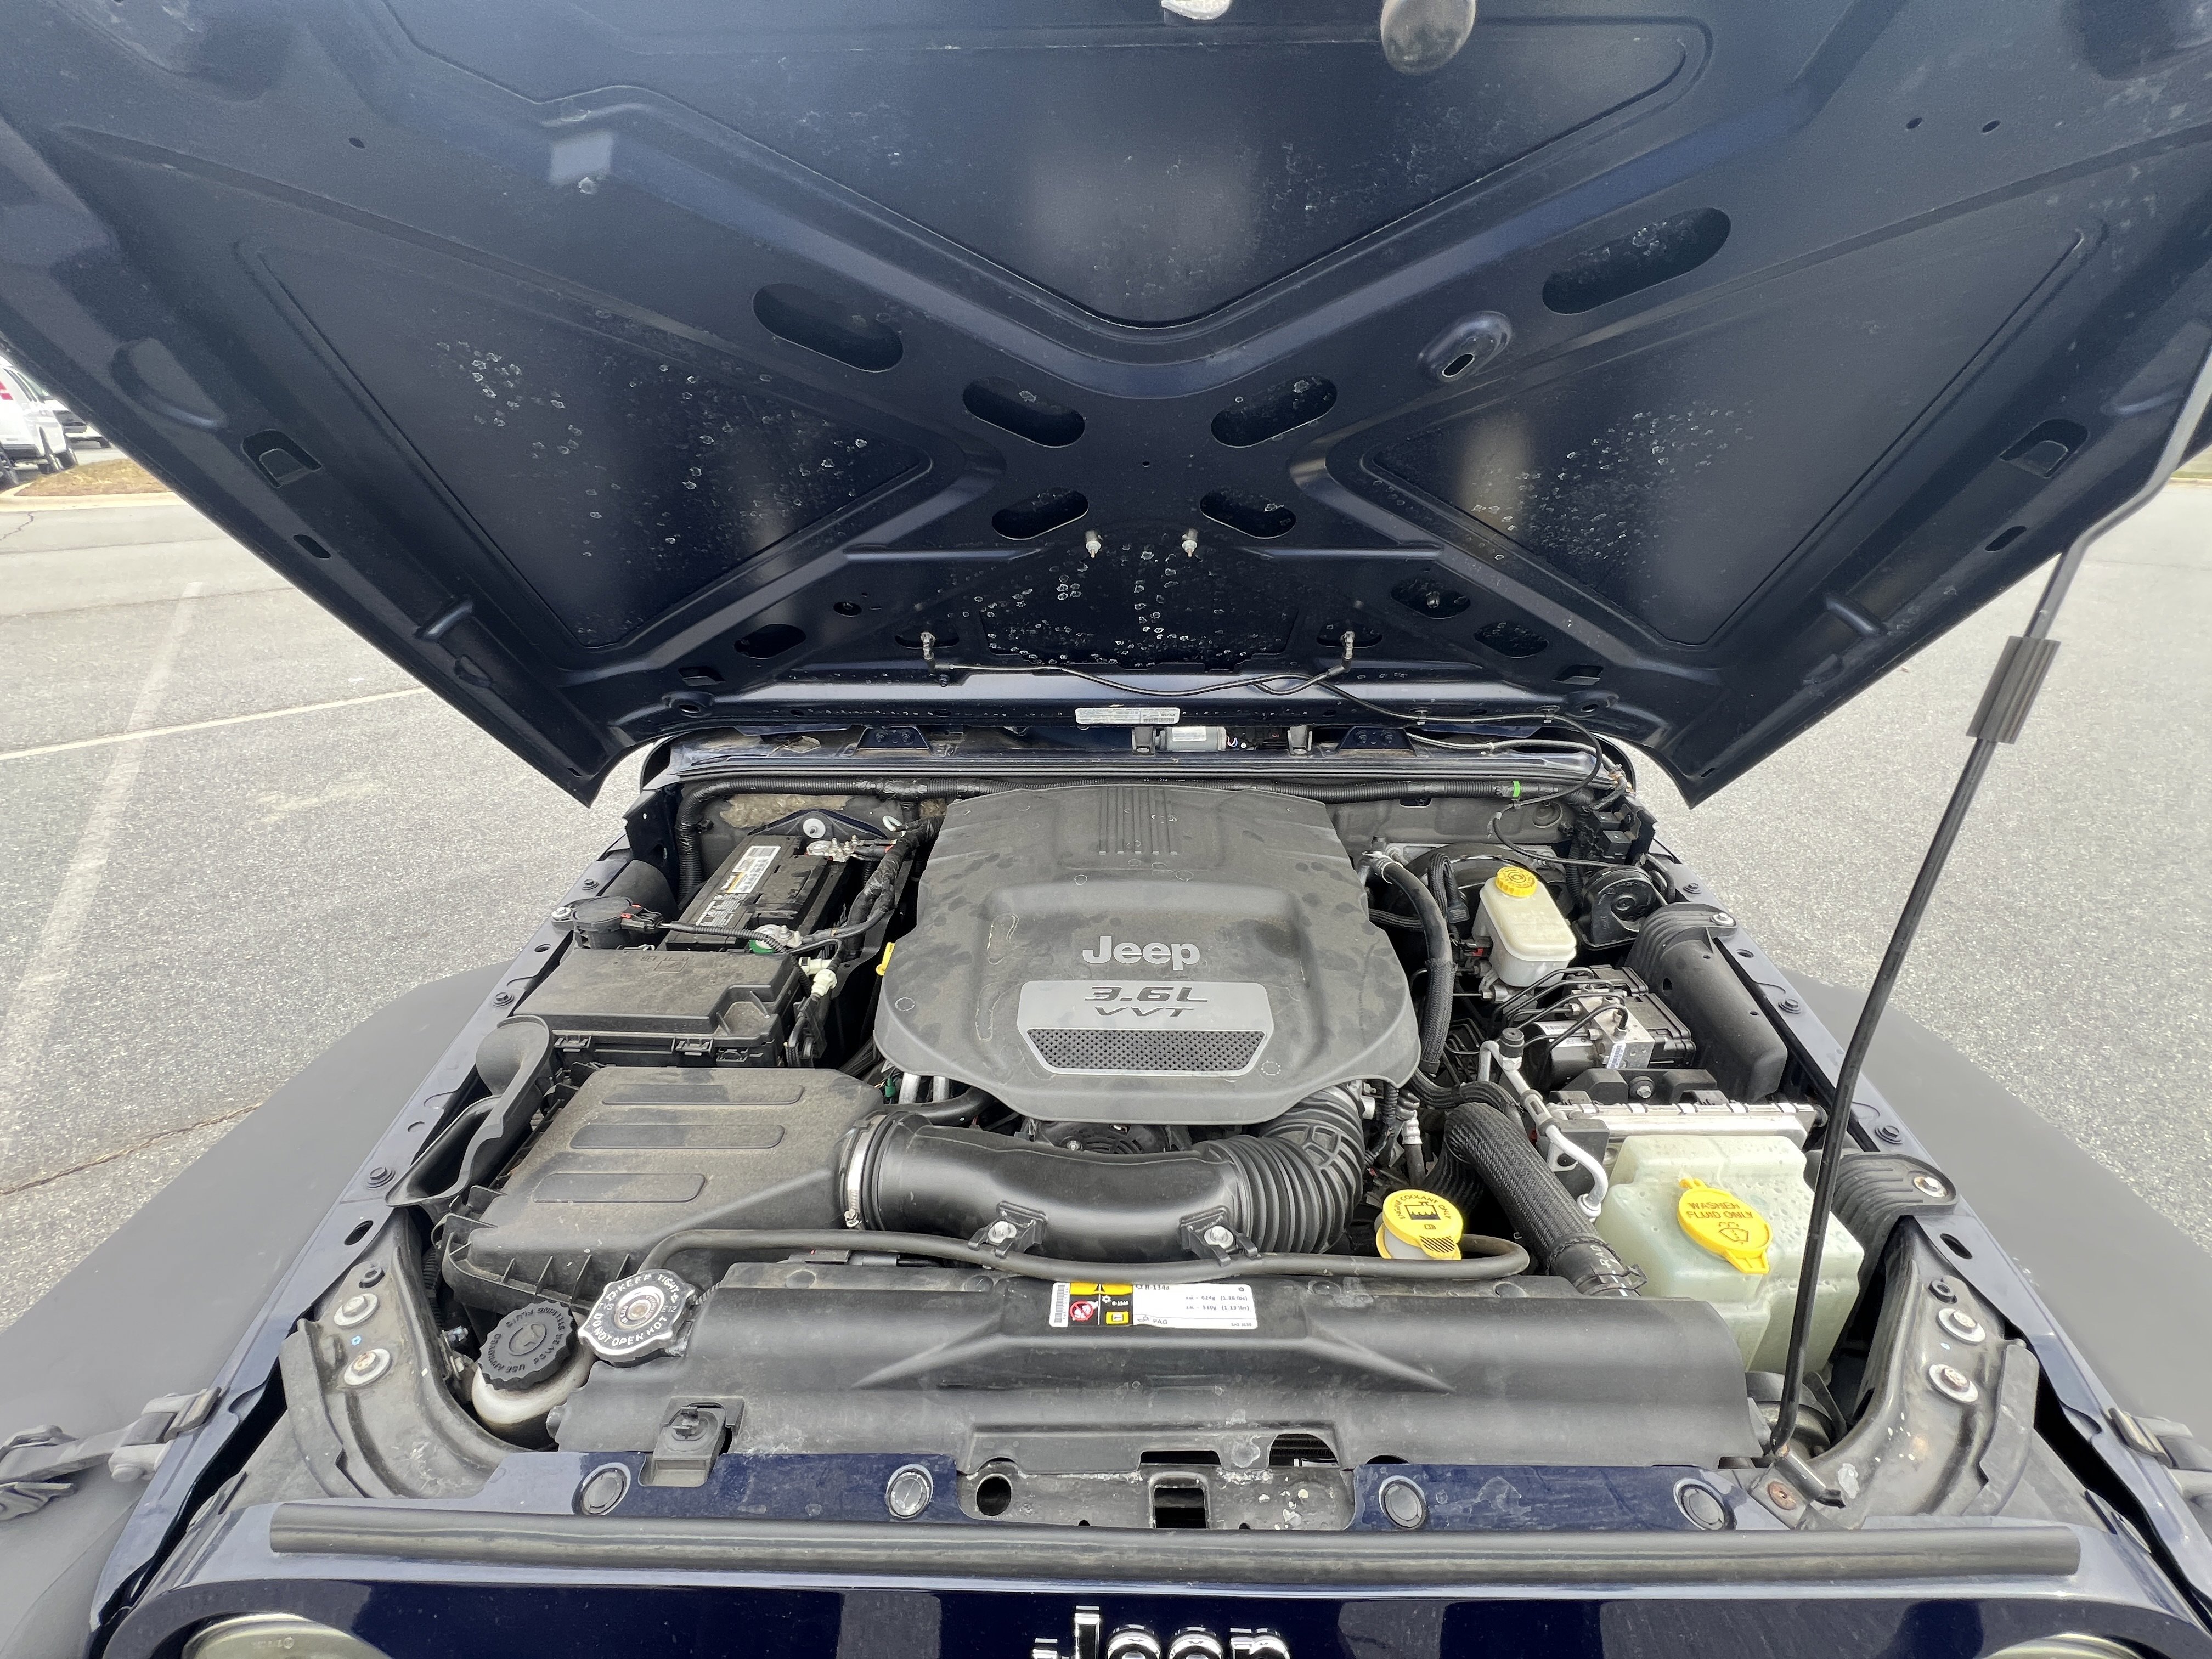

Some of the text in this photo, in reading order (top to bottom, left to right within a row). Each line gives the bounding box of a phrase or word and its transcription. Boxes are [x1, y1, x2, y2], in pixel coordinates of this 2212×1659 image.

[1082, 935, 1200, 970] Jeep
[1084, 986, 1208, 1002] 3.6L
[1094, 1006, 1194, 1017] VVT
[1400, 1194, 1438, 1204] COOLANT
[1438, 1204, 1452, 1220] ONLY
[1685, 1211, 1753, 1219] FLUID ONLY
[1686, 1201, 1740, 1210] WASHER
[1590, 1245, 1611, 1269] RAD
[618, 1274, 680, 1293] KEEP TIGHT
[505, 1308, 534, 1328] FLUID
[592, 1313, 668, 1346] DO NOT OPEN HOT
[505, 1364, 526, 1373] USE
